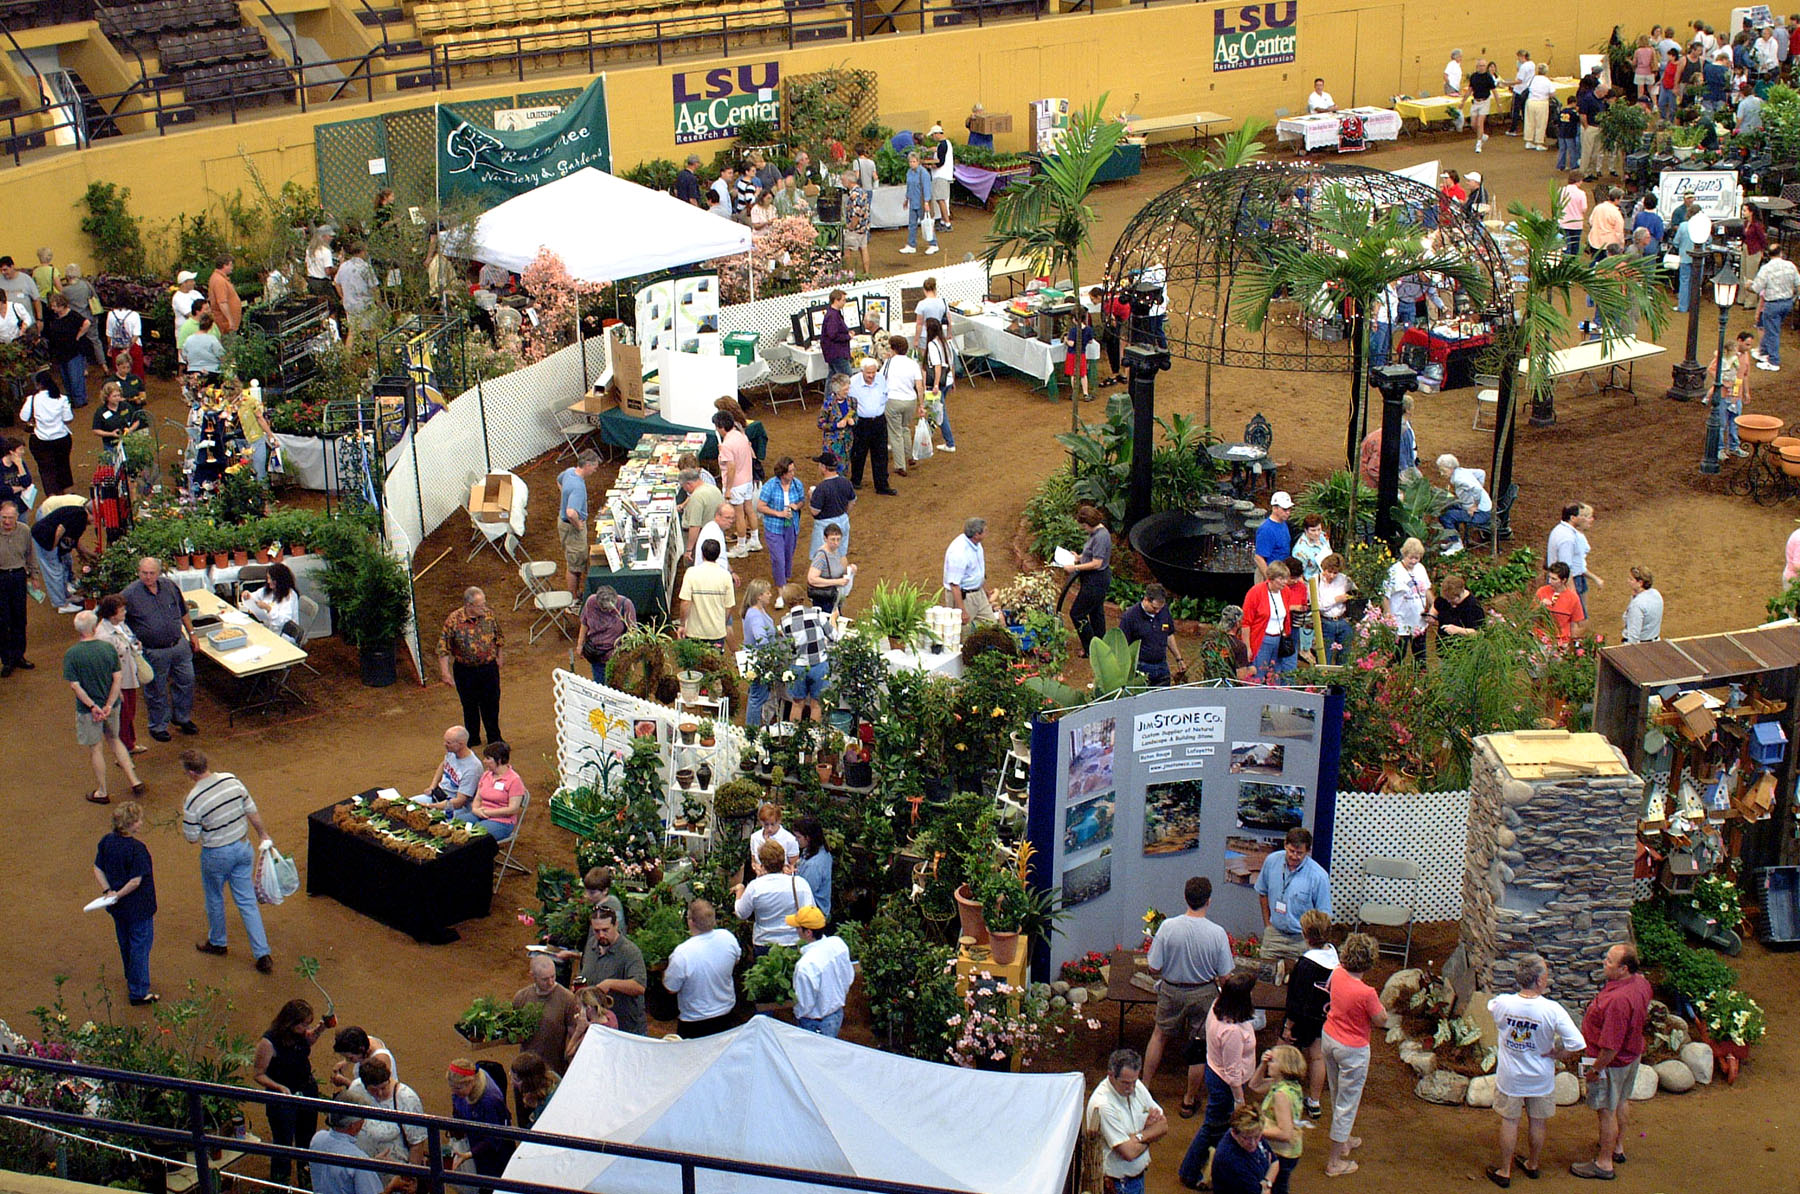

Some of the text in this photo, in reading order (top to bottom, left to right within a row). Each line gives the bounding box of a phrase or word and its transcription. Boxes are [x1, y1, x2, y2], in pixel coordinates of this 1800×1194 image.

[1214, 1, 1296, 35] LSU
[1214, 60, 1247, 71] Research
[1258, 55, 1294, 65] Extension
[672, 61, 779, 103] LSU
[676, 130, 718, 143] Research
[722, 127, 729, 137] &
[481, 147, 603, 186] Nursery & Gardens
[1141, 731, 1159, 739] Custom
[1162, 729, 1183, 737] Supplier
[1141, 738, 1167, 746] Landscape
